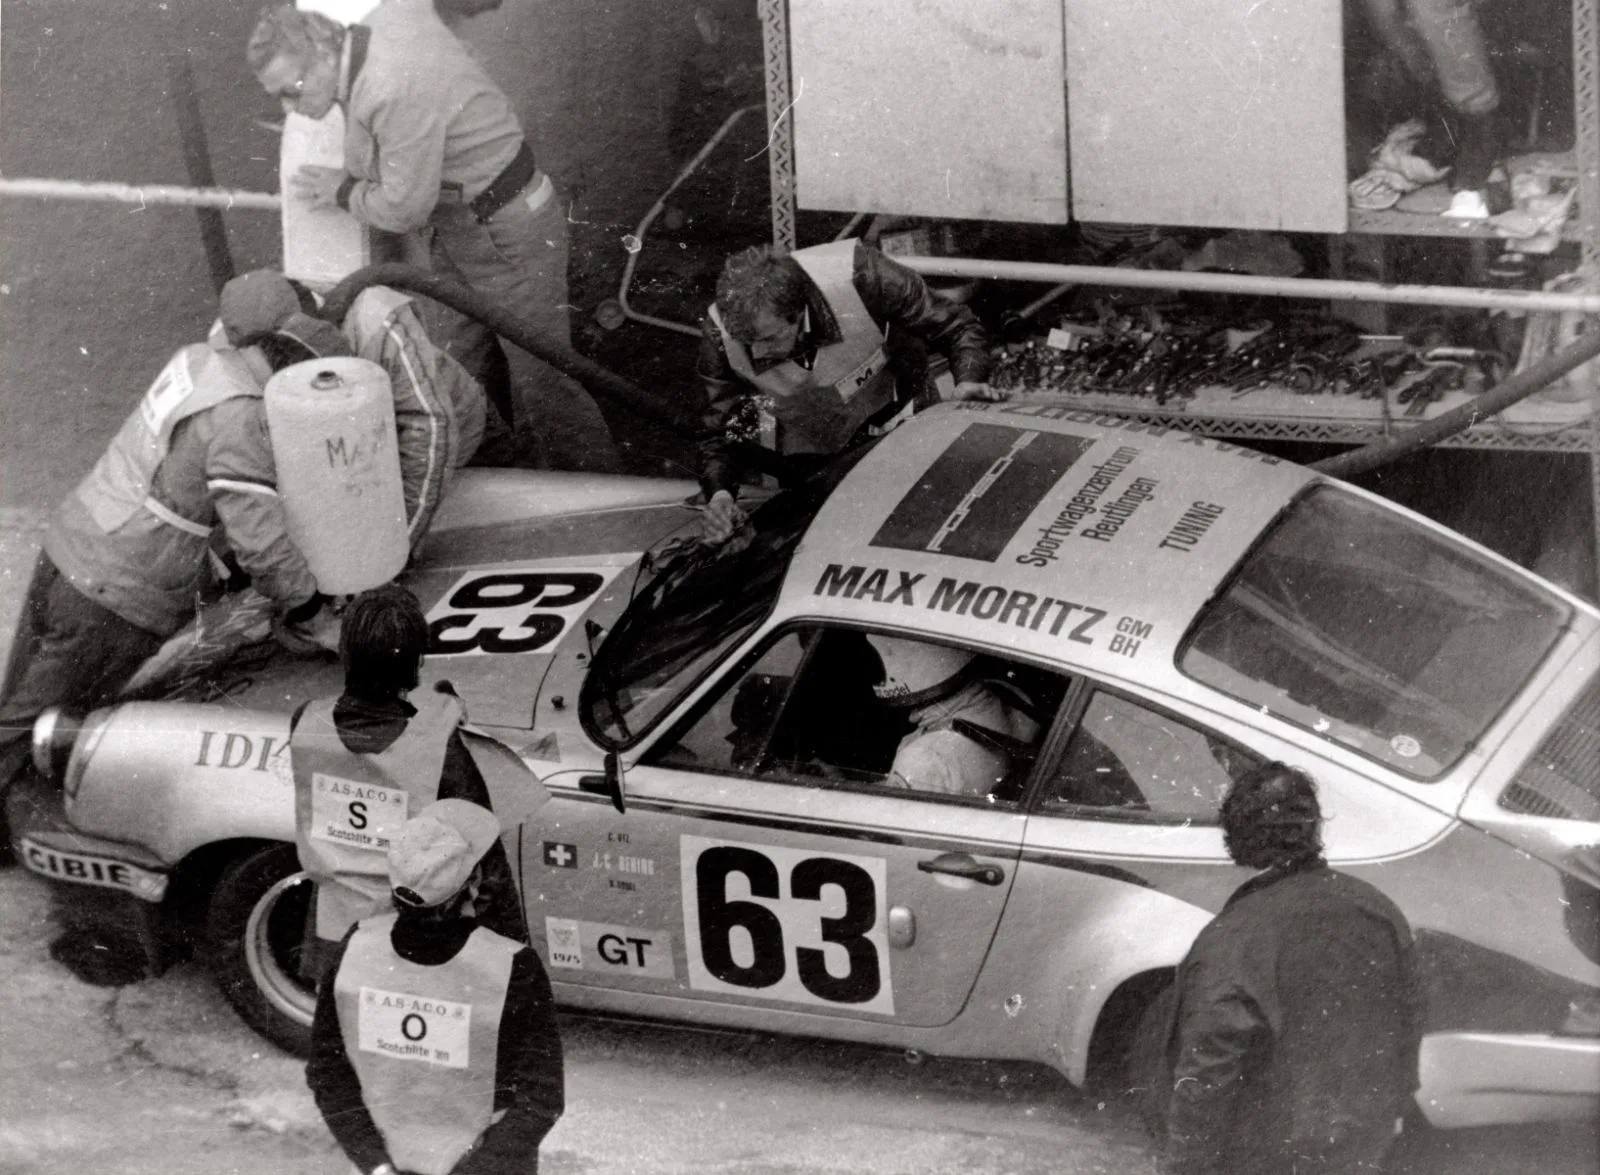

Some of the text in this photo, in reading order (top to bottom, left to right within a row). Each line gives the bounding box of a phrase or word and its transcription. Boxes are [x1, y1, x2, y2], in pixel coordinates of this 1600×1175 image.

[1016, 446, 1141, 568] Sportwagenzentrum
[1159, 500, 1225, 552] TUNING
[813, 563, 1108, 645] MAX MORITZ
[1116, 615, 1154, 640] GM
[1108, 637, 1141, 659] BH
[348, 801, 368, 830] S
[696, 846, 881, 1004] 63
[597, 934, 652, 967] GT
[401, 1013, 427, 1041] O
